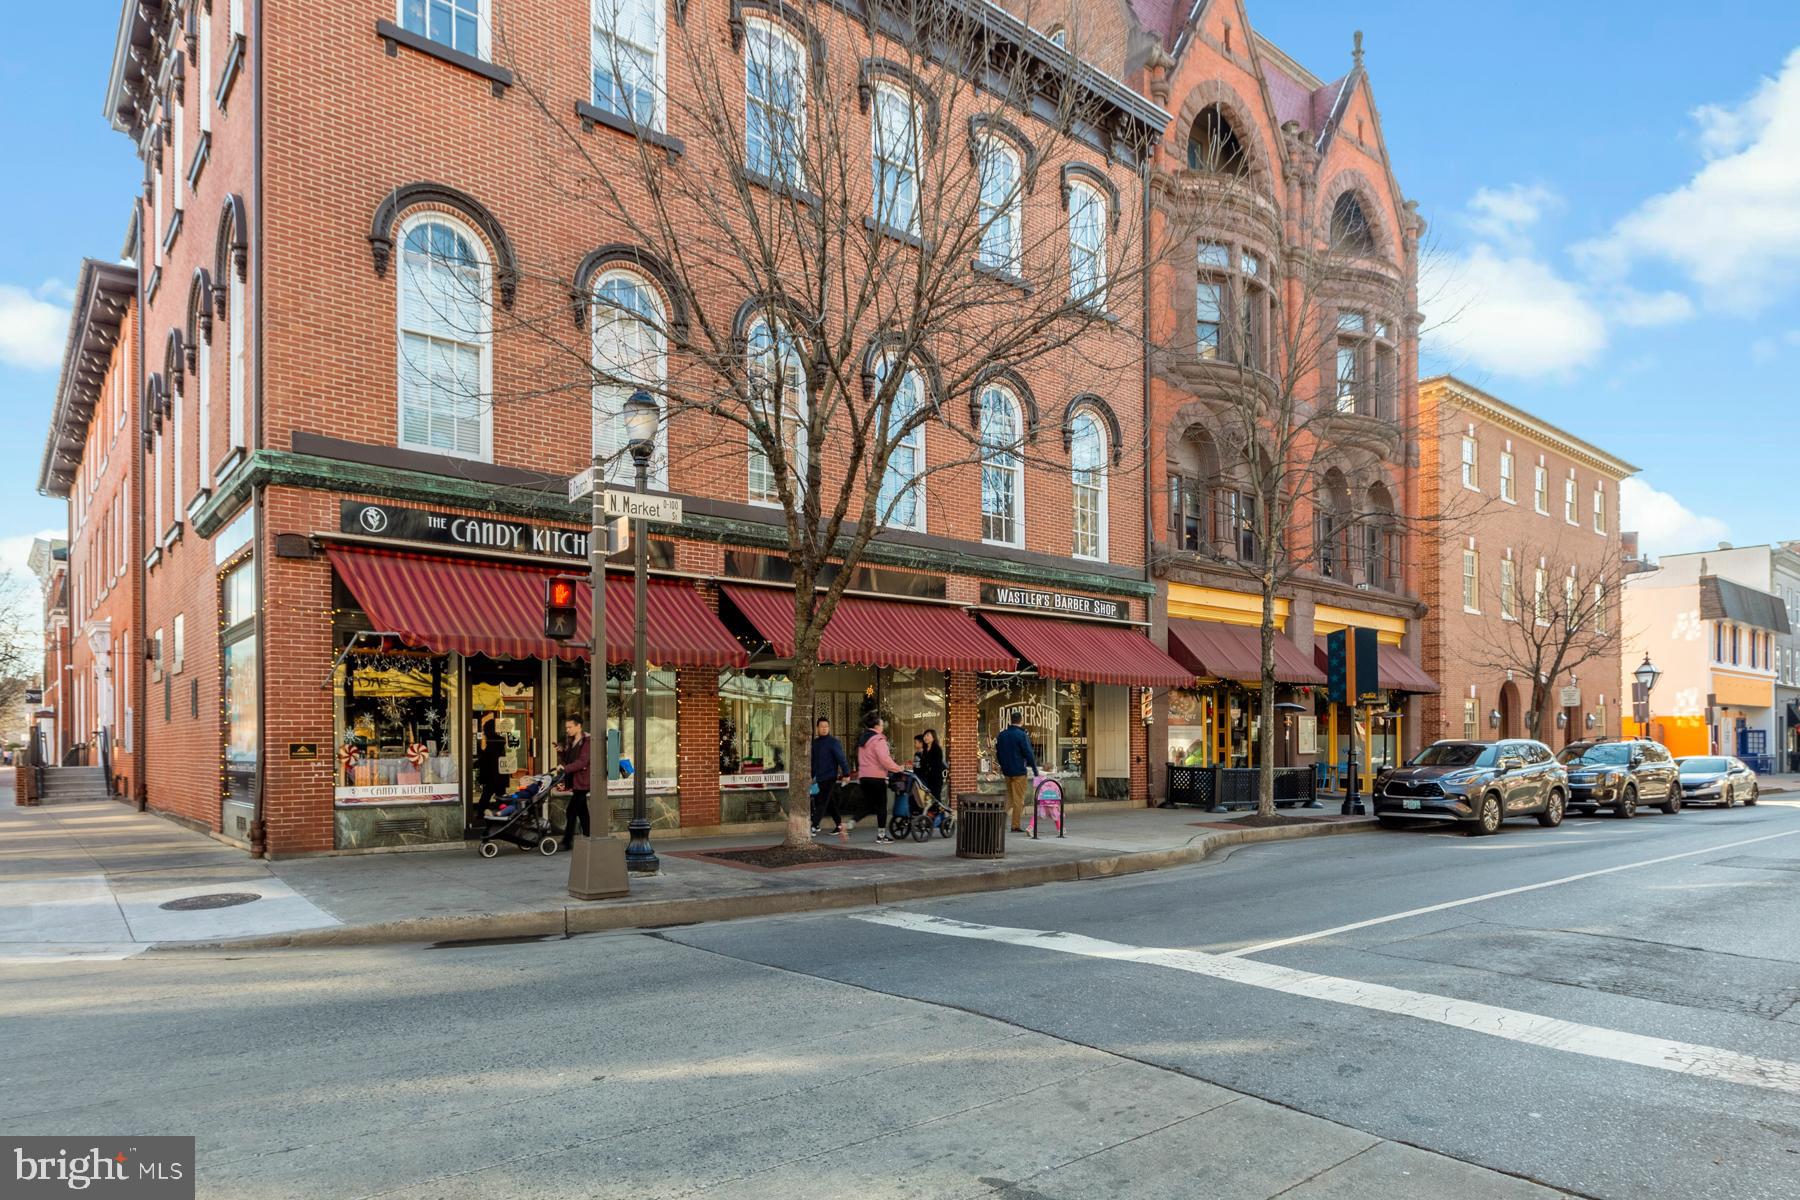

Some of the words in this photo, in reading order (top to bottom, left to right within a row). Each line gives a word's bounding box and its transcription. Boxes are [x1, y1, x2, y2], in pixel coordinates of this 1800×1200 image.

[610, 494, 621, 513] N.
[623, 495, 660, 518] Market
[427, 516, 447, 529] THE
[451, 519, 522, 548] CANDY
[533, 528, 589, 556] KITCH
[997, 588, 1050, 607] WASTLER'S
[1054, 593, 1090, 612] BARBER
[1094, 600, 1117, 616] SHOP
[370, 787, 398, 796] CANDY
